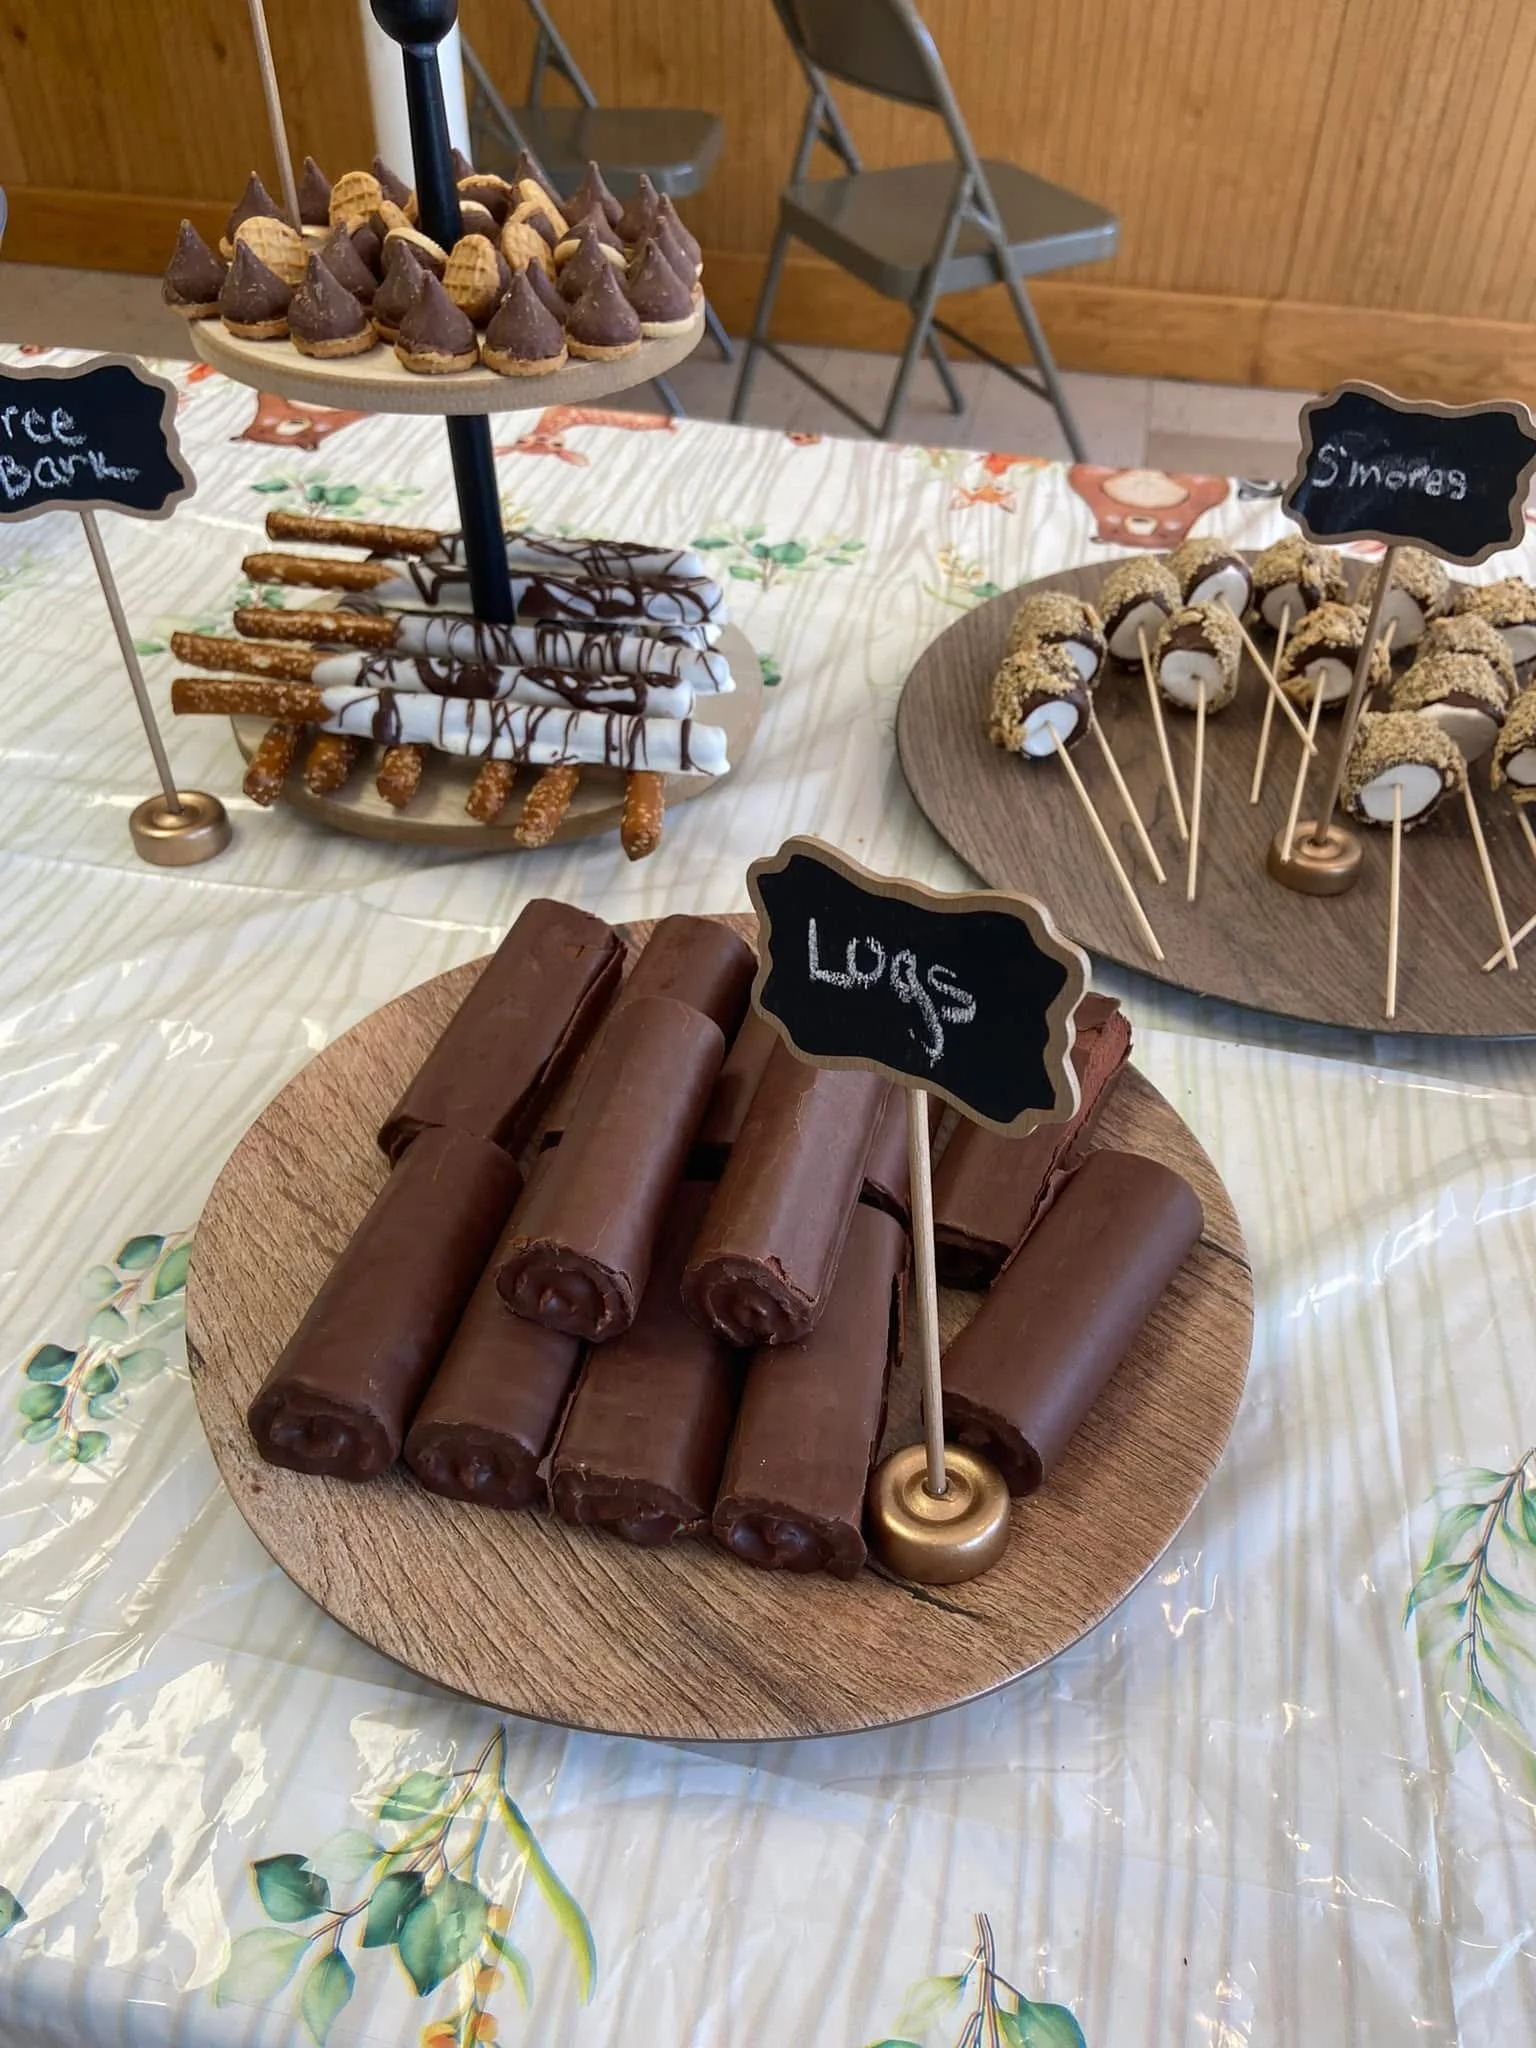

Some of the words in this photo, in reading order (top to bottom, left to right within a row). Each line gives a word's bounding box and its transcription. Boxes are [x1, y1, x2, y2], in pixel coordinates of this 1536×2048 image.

[0, 405, 88, 447] ree
[0, 450, 142, 500] Bark
[1312, 443, 1467, 500] S'mores
[807, 918, 977, 1069] Logs
